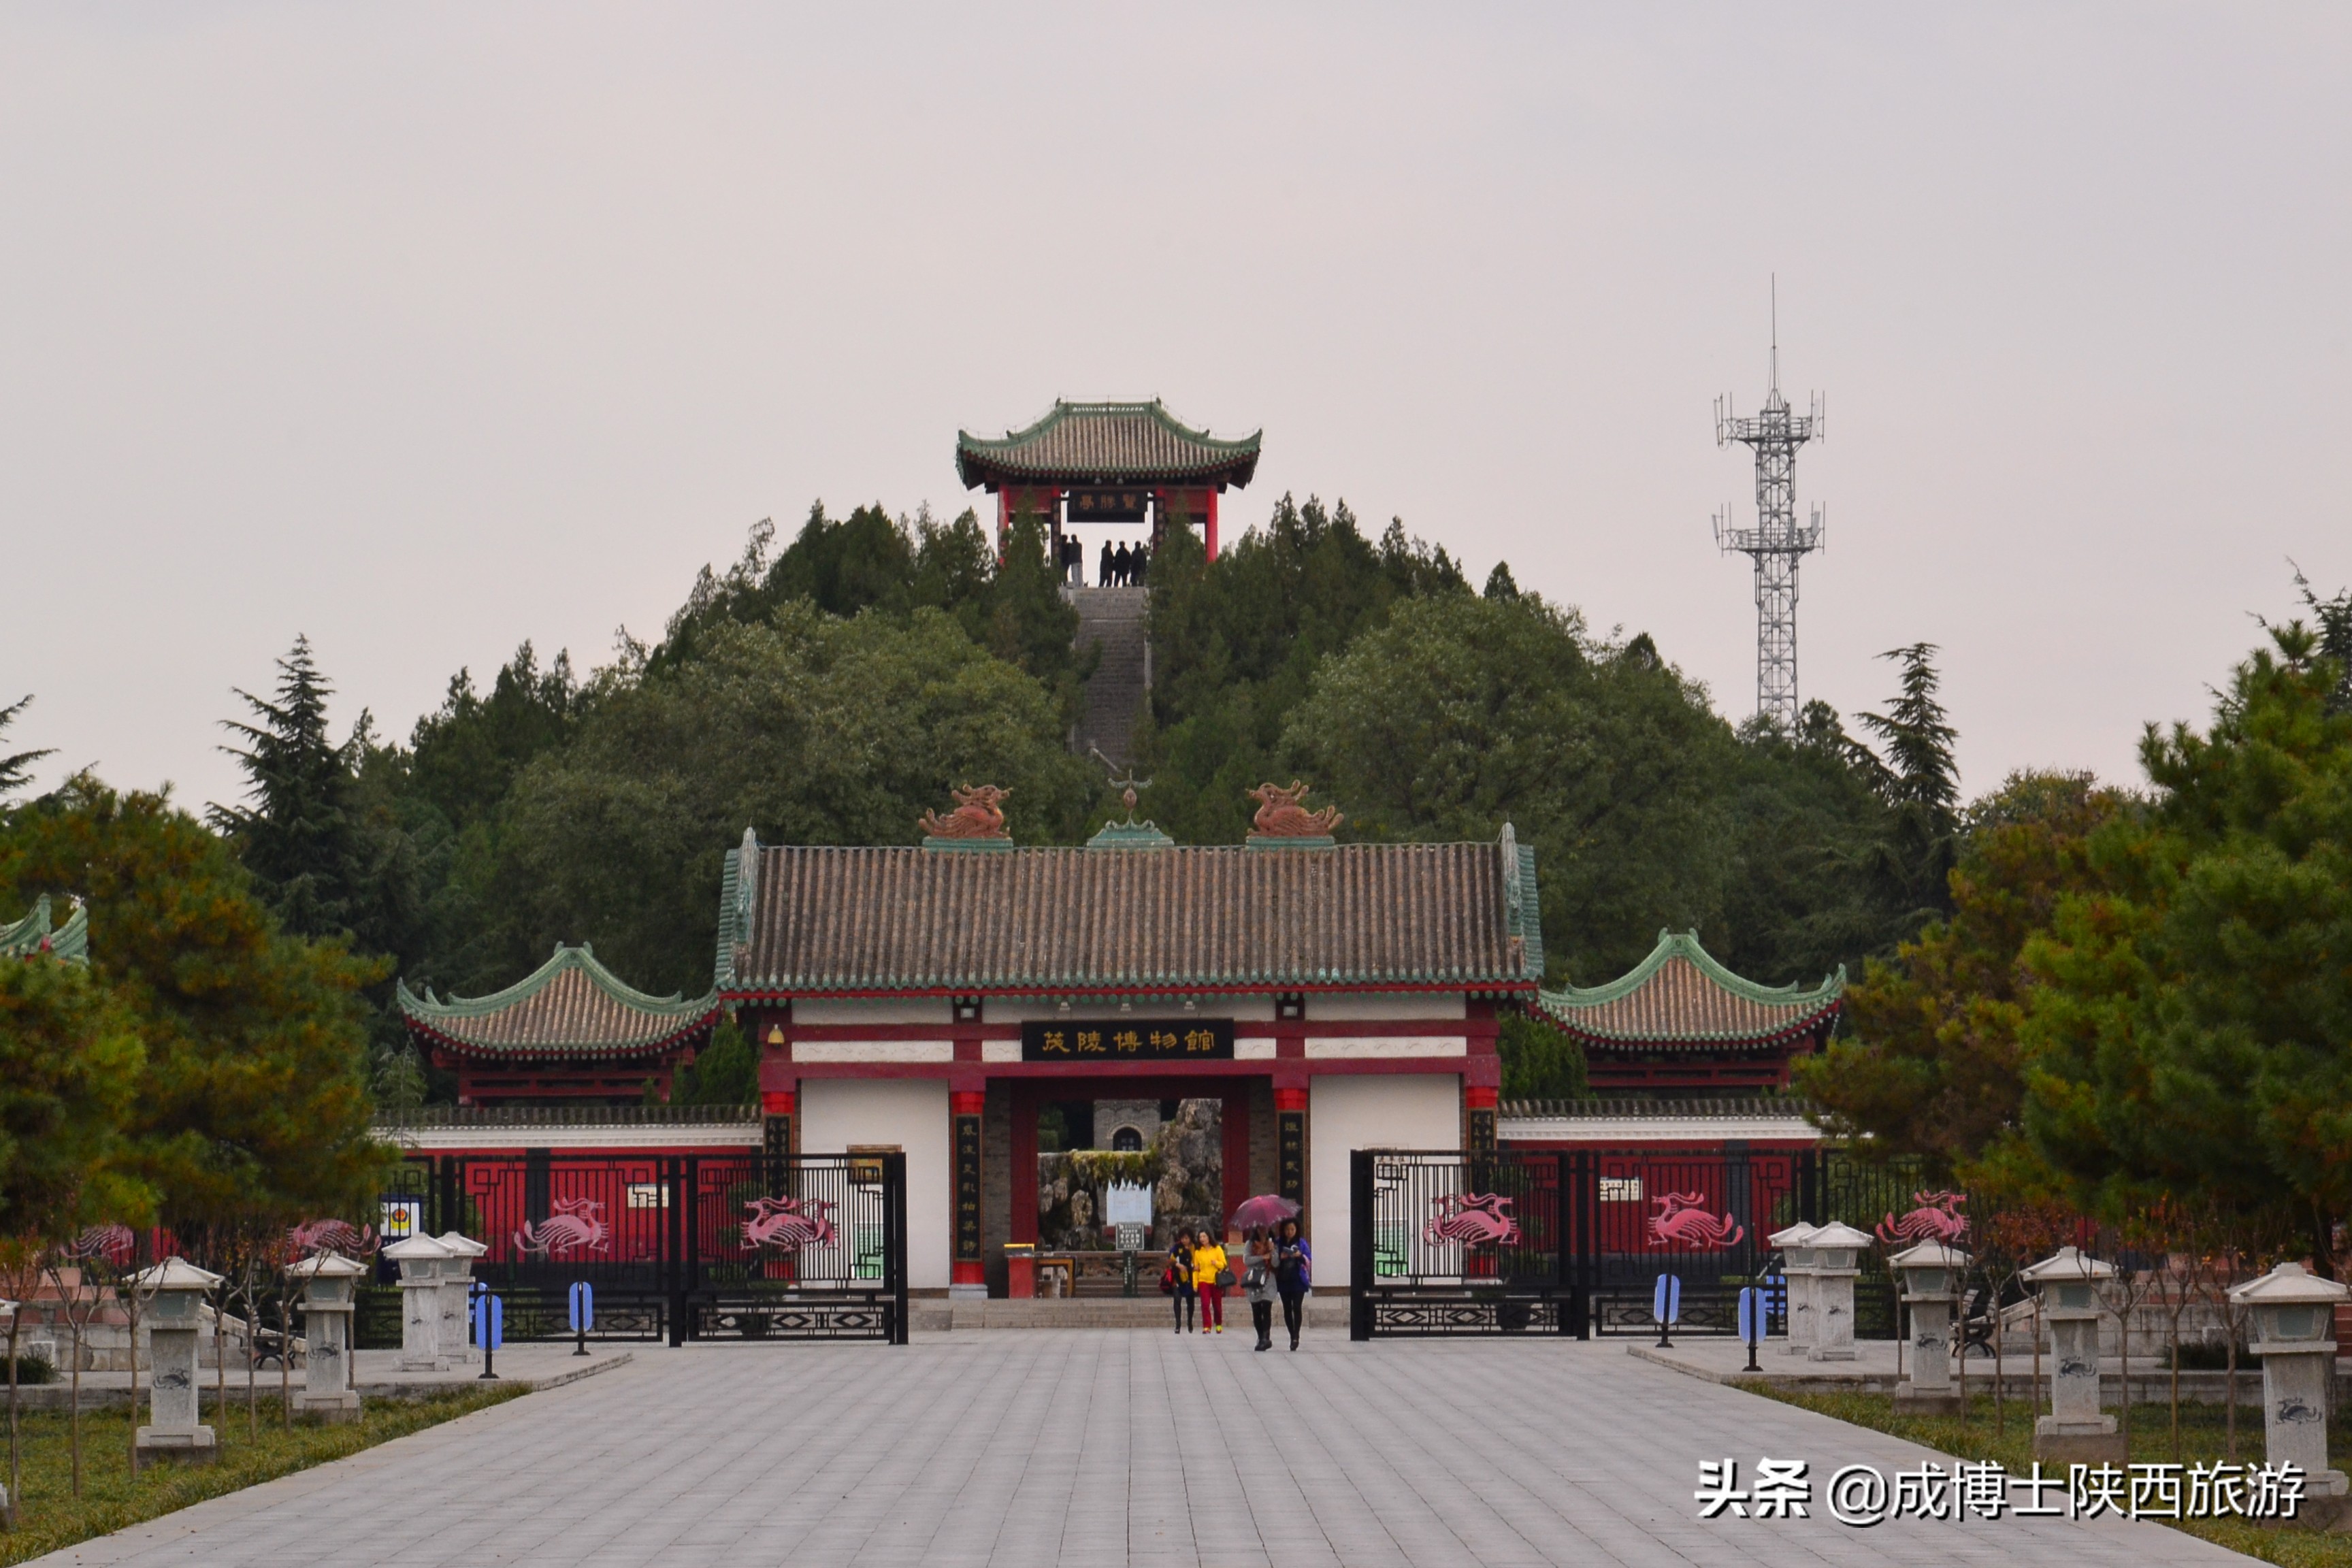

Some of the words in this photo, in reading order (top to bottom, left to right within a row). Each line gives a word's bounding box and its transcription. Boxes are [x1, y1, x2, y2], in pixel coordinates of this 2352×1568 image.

[1042, 1029, 1215, 1053] 茂陵博物館
